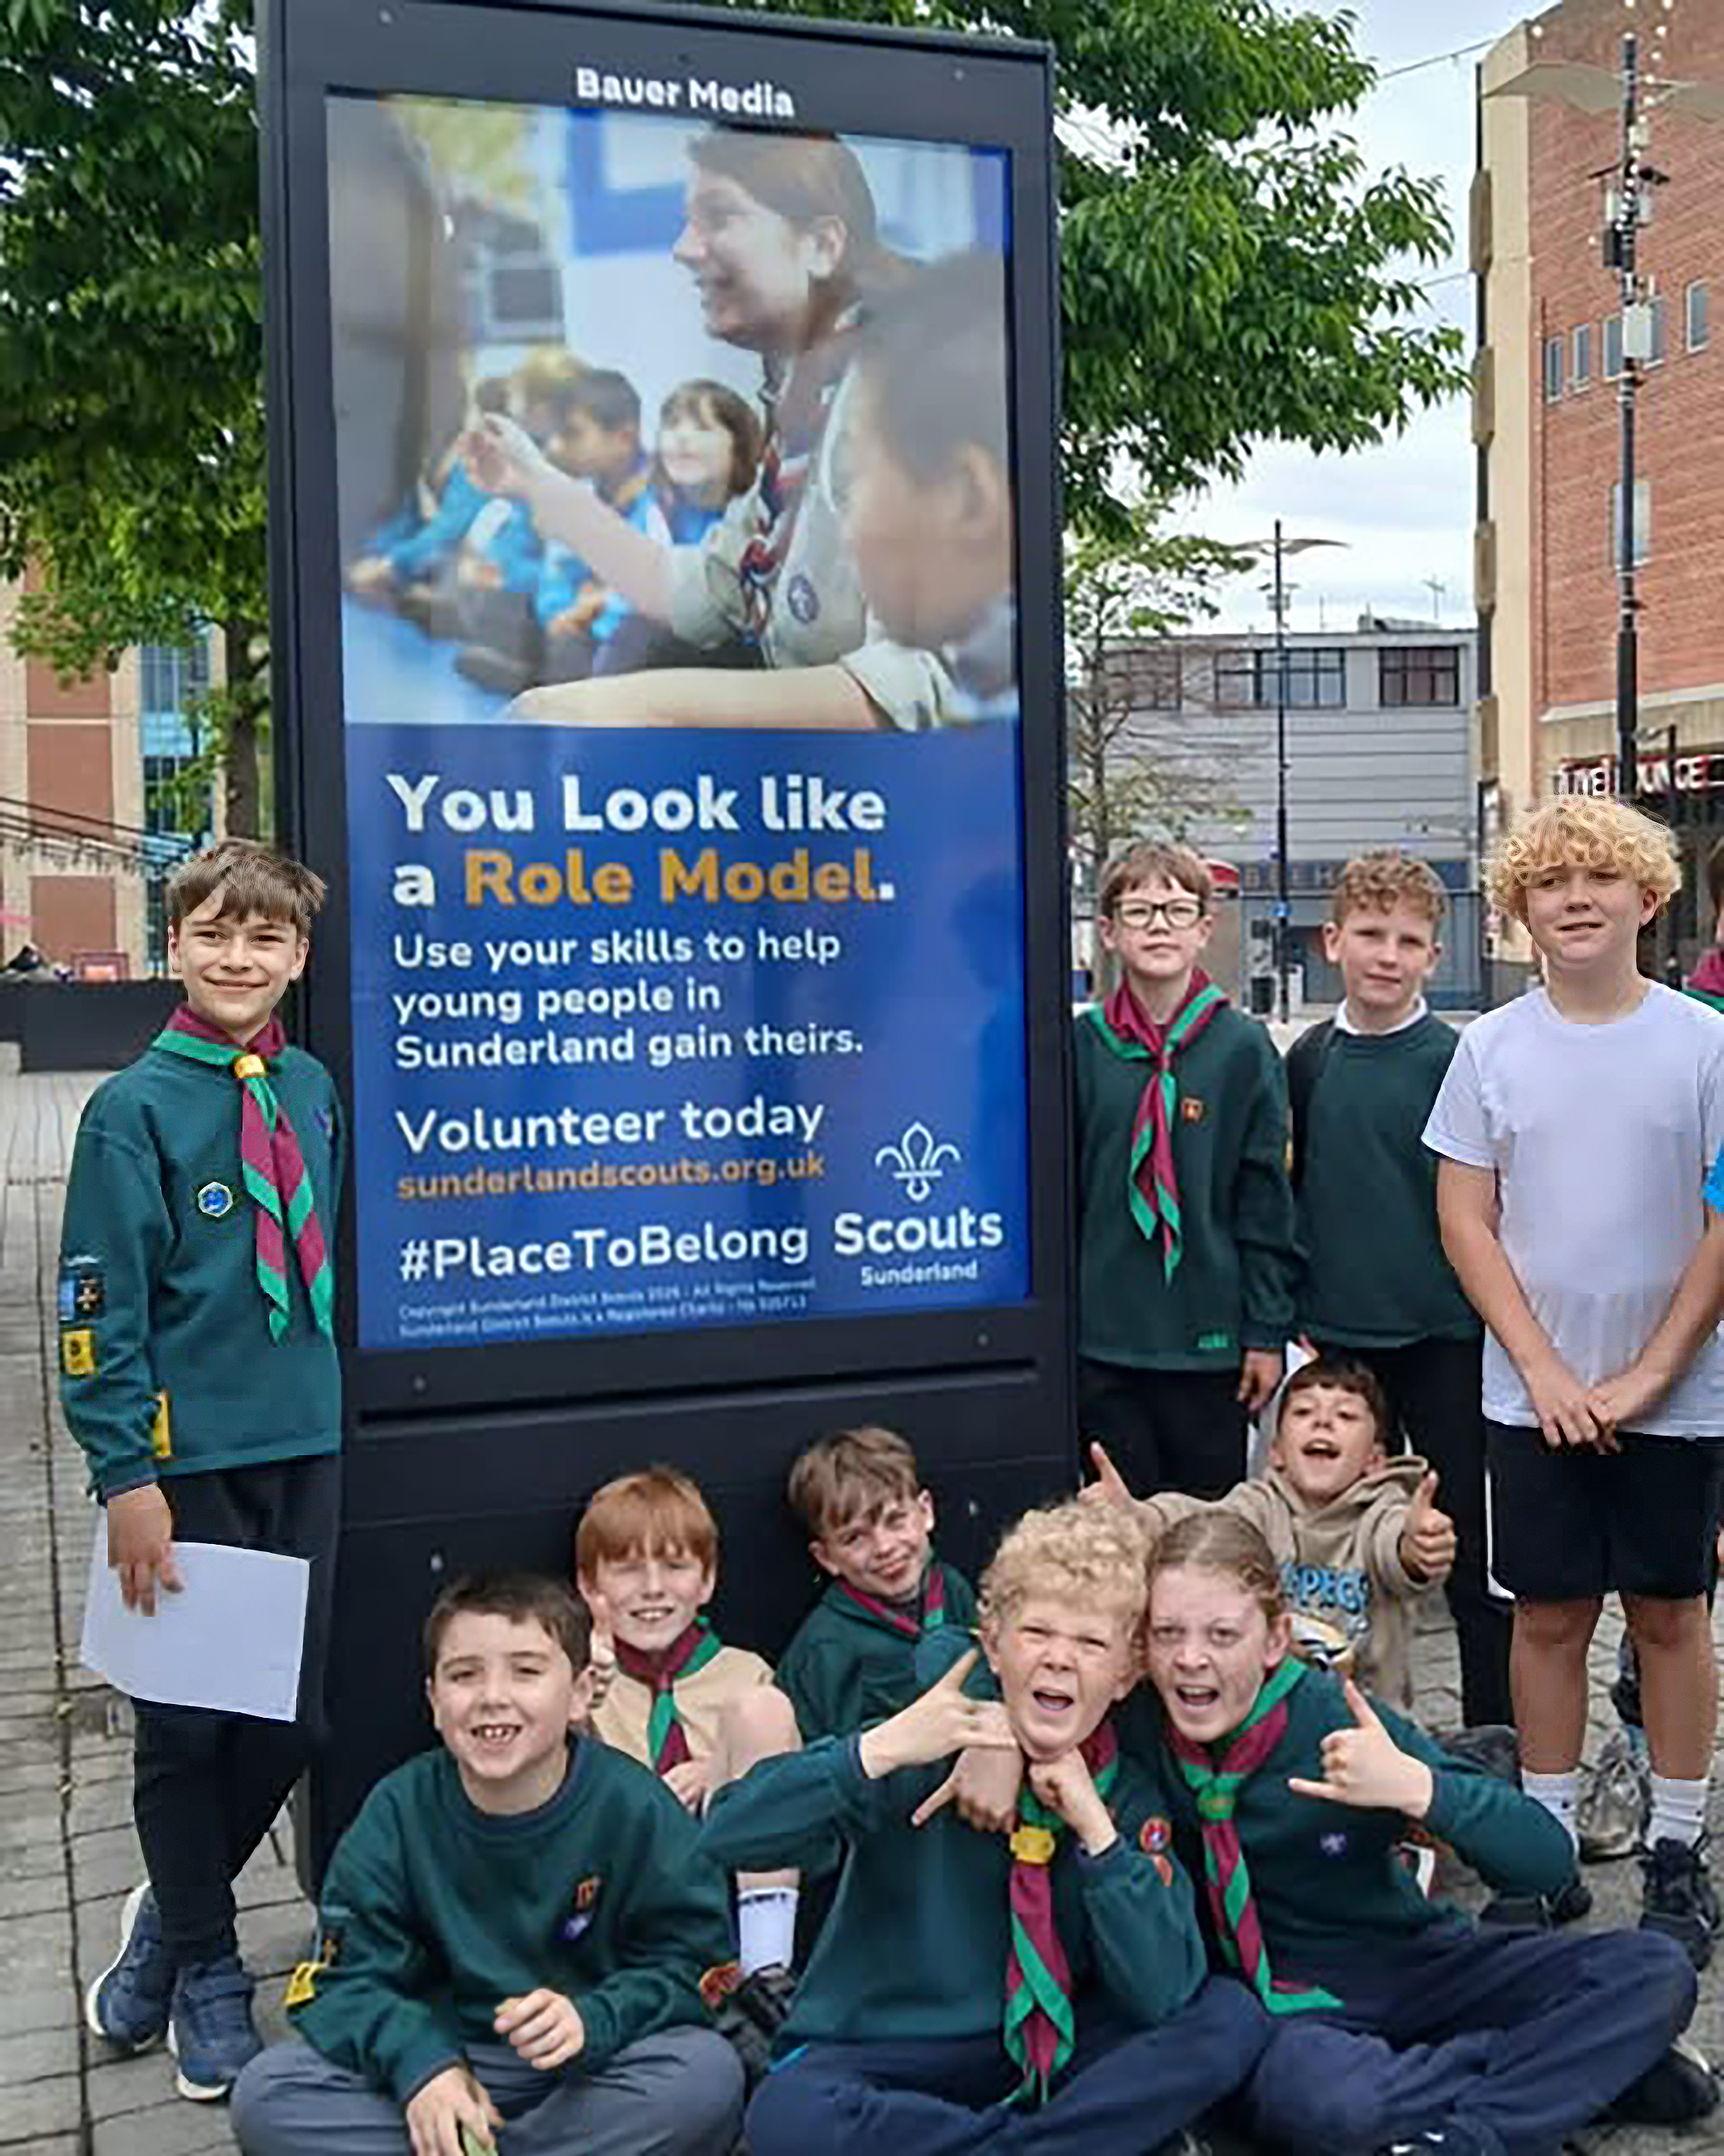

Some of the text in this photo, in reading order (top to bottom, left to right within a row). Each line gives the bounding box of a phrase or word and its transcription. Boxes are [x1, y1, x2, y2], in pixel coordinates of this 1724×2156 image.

[575, 67, 795, 117] Bauer Media
[386, 774, 886, 832] You Look like
[394, 848, 896, 906] a Role Model.
[394, 928, 841, 974] Use your skills to help
[394, 977, 721, 1026] young people in
[396, 1023, 864, 1070] Sunderland gain theirs.
[396, 1096, 824, 1153] Volunteer today
[397, 1154, 825, 1200] sunderlandscouts.org.uk
[399, 1221, 808, 1281] #PlaceToBelong
[833, 1206, 1003, 1255] Scouts
[861, 1259, 978, 1286] Sunderland
